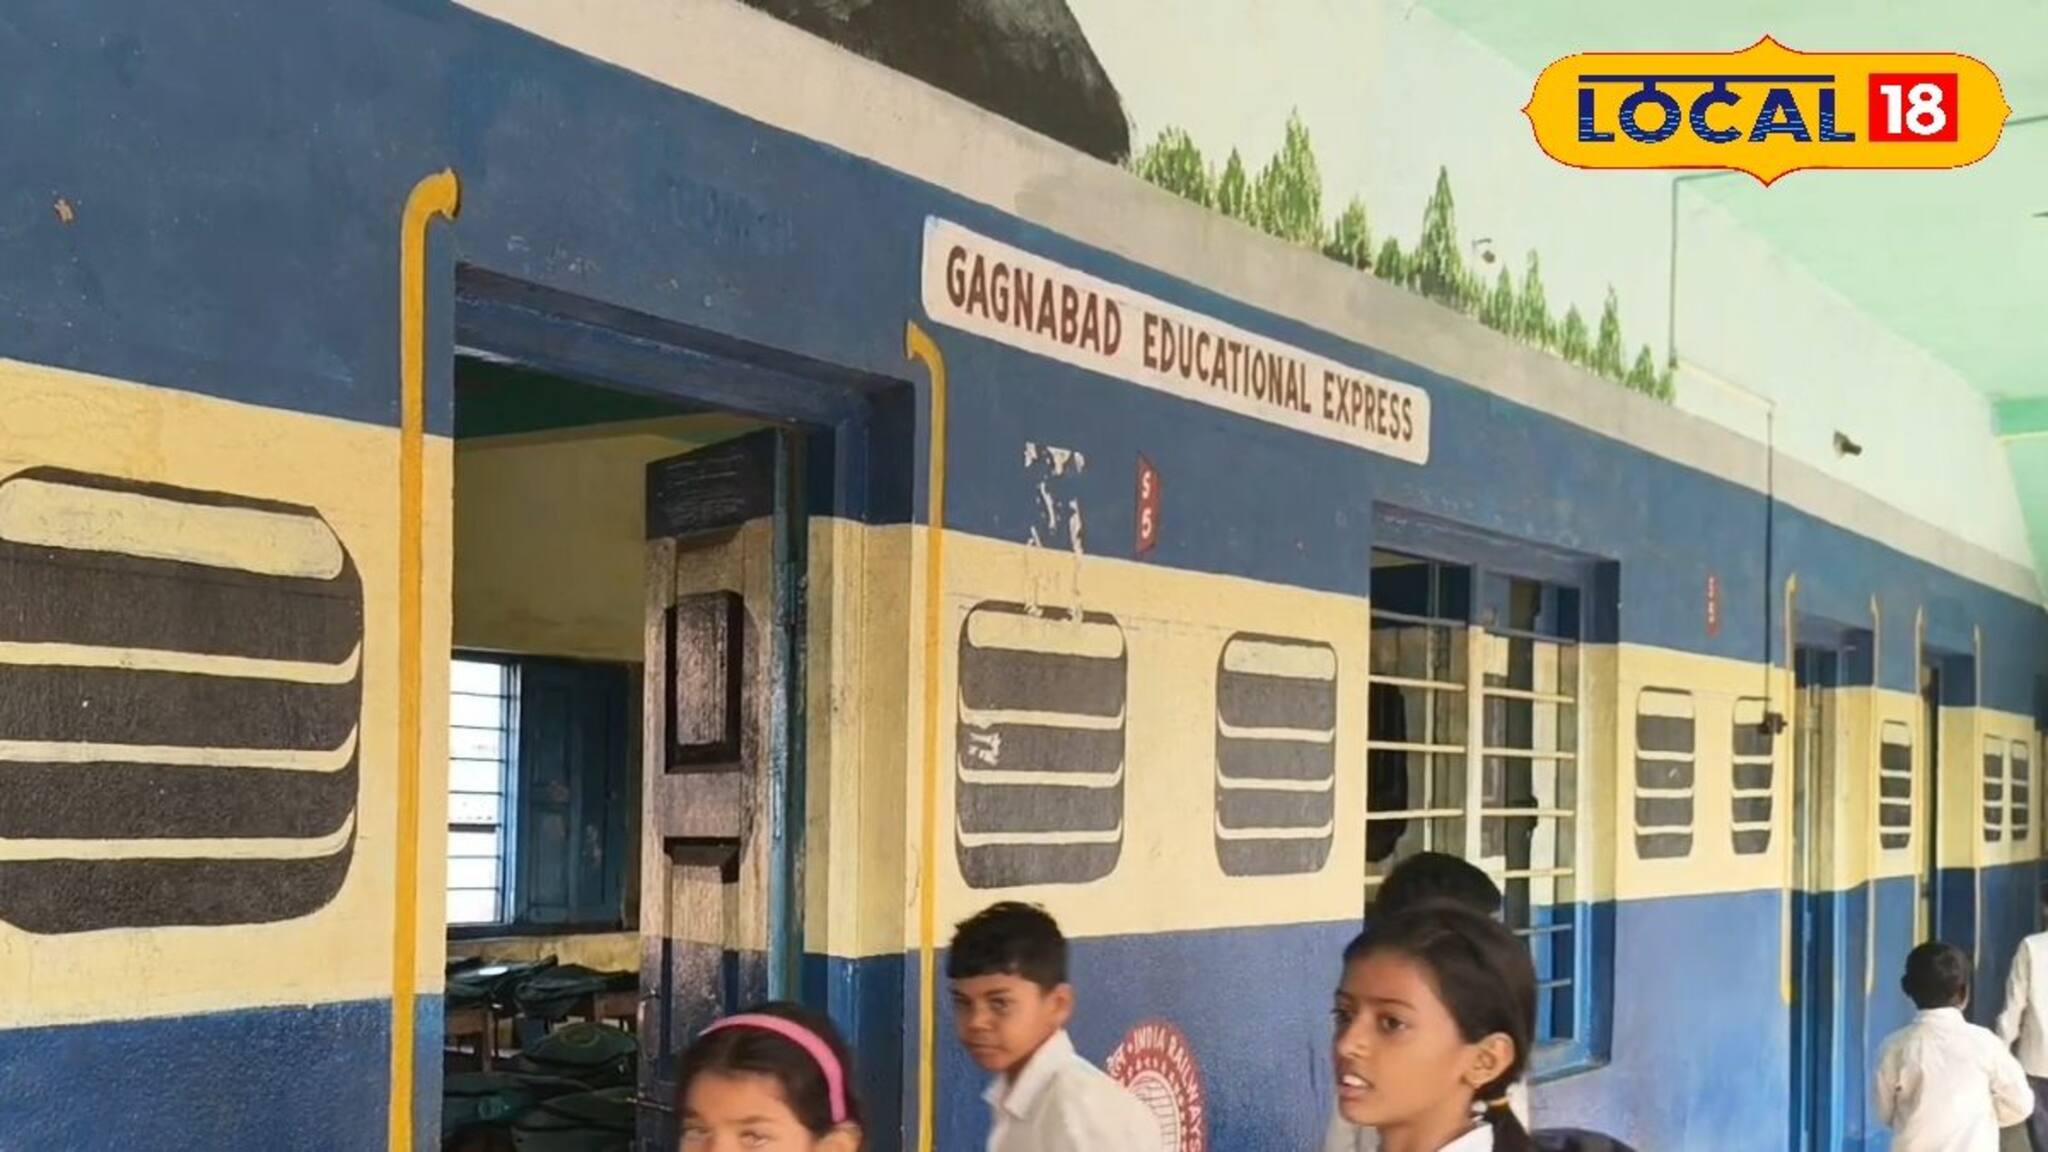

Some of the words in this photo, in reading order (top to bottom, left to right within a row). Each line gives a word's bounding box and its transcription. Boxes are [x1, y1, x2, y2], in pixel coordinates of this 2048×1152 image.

[946, 245, 1122, 356] GAGNABAD
[1142, 311, 1312, 414] EDUCATIONAL
[1323, 370, 1413, 442] EXPRESS
